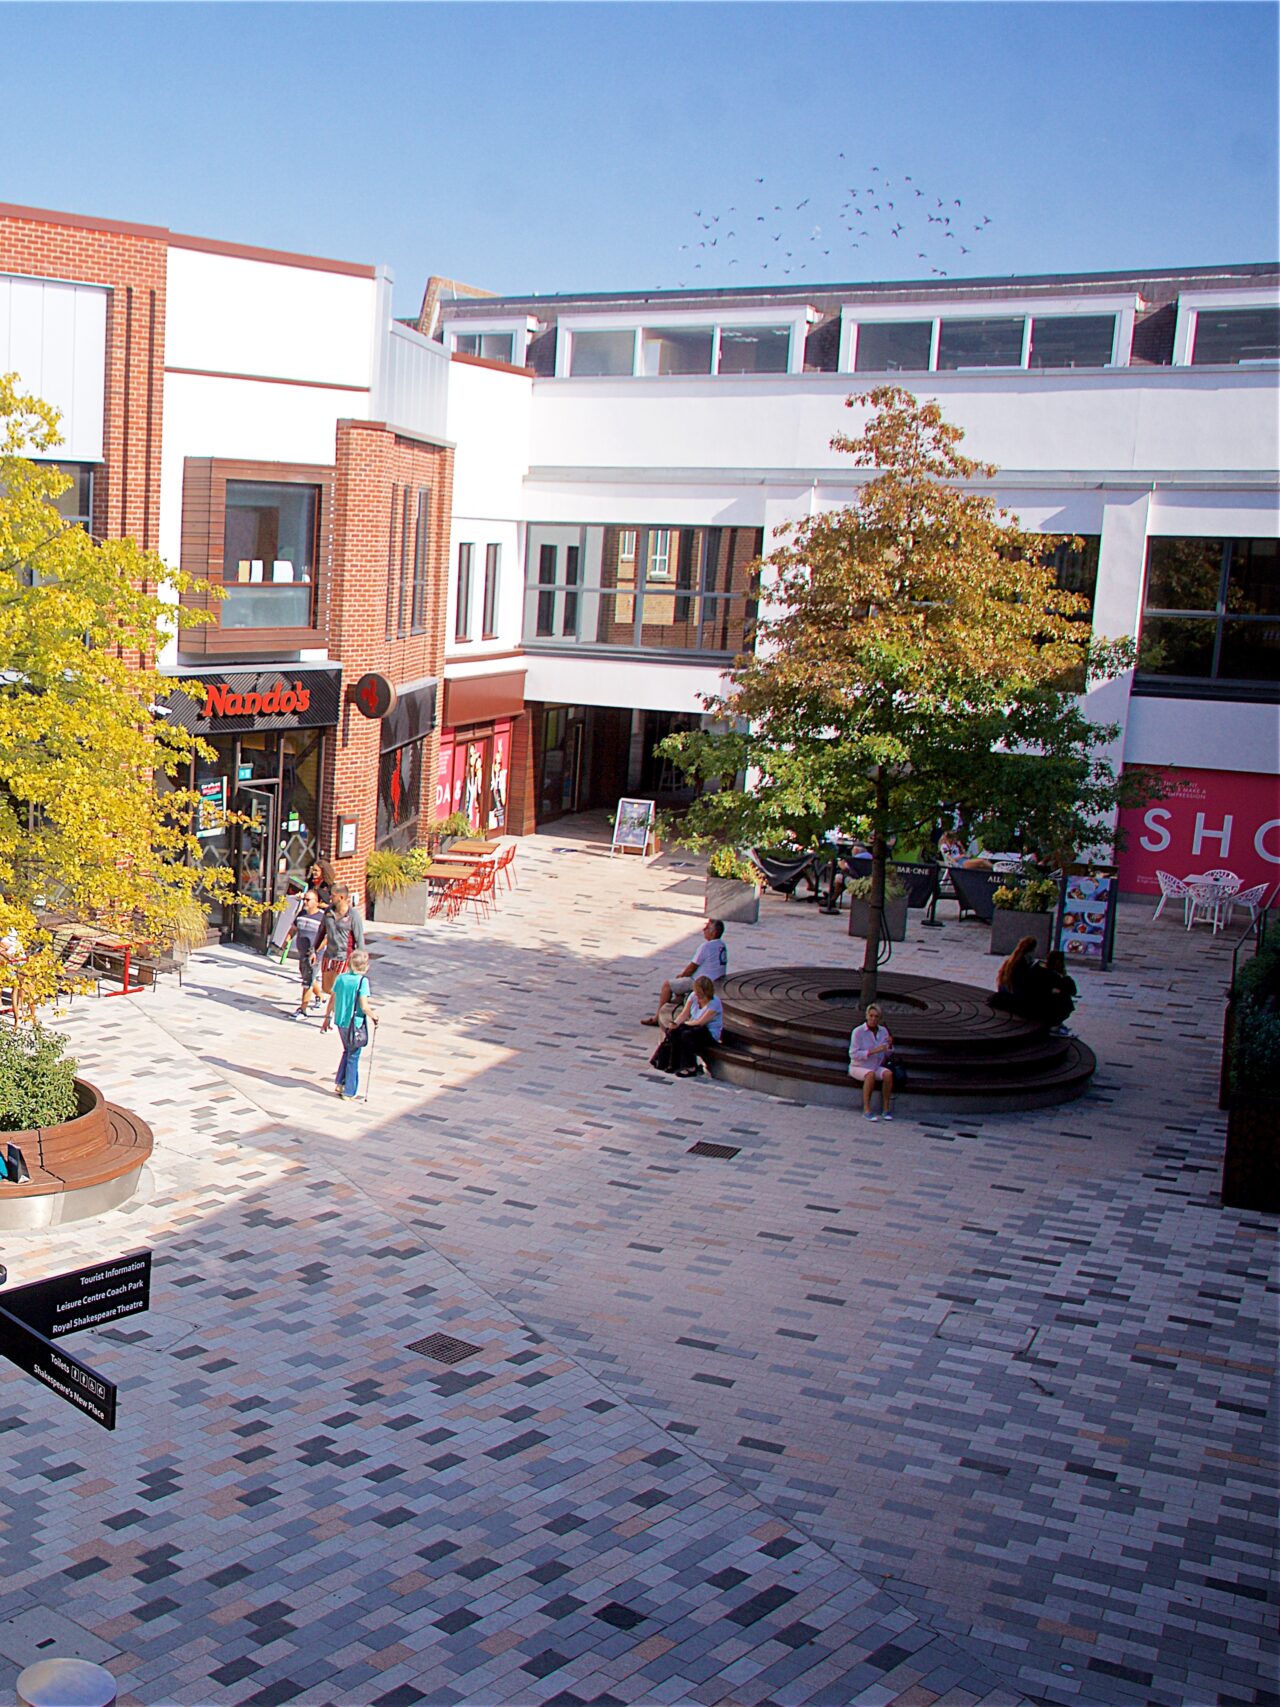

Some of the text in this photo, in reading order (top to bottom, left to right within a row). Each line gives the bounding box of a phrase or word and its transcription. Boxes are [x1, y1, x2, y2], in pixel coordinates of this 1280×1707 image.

[203, 681, 310, 717] Nando's
[80, 1262, 146, 1286] Tourist Information
[56, 1280, 144, 1312] Leisure Centre Coach Park
[52, 1300, 144, 1334] Royal Shakespeare Theatre
[50, 1353, 70, 1374] Toilets
[34, 1364, 104, 1420] Shakespeare's New Place
